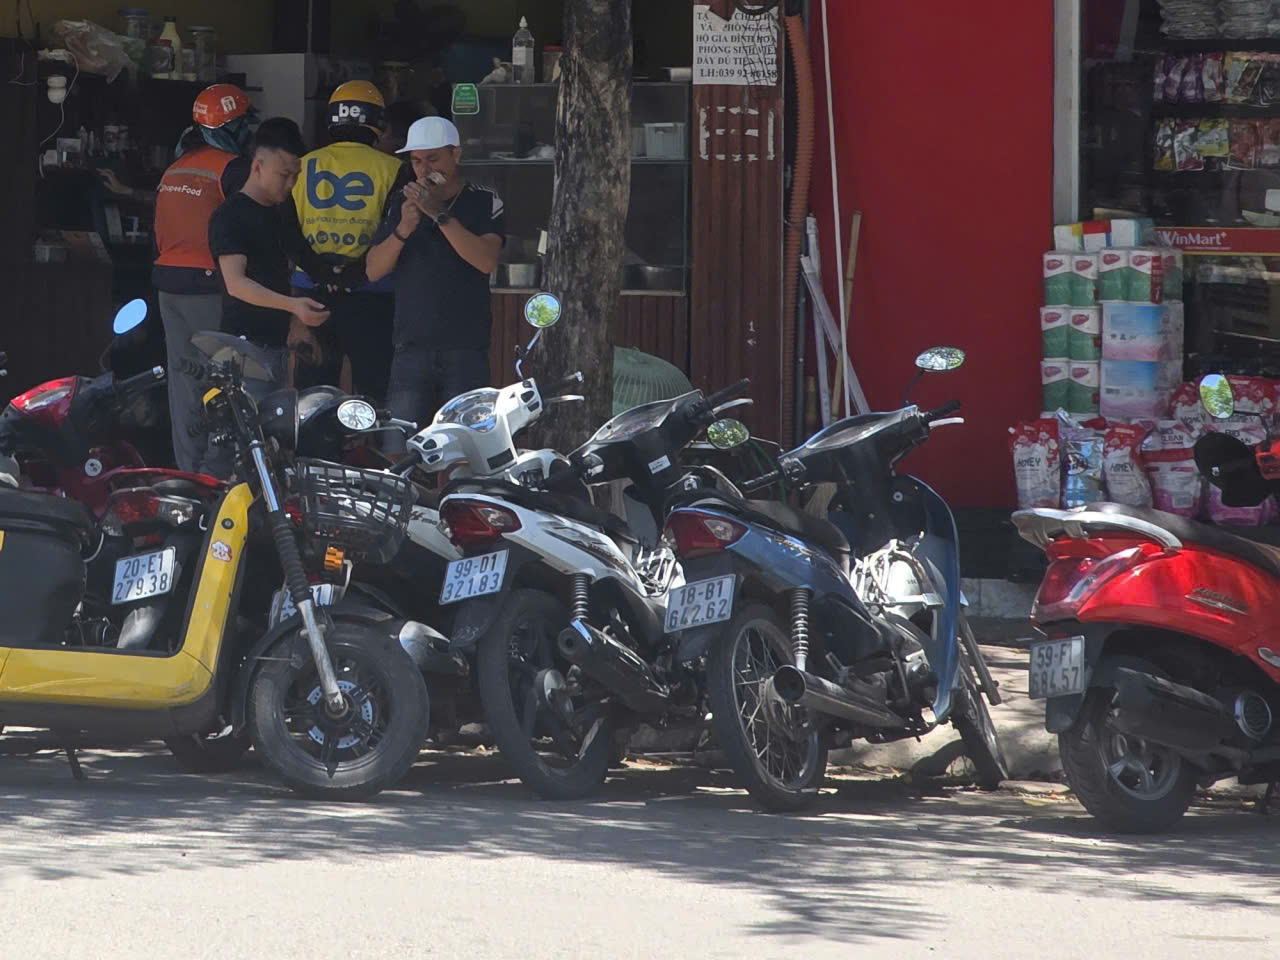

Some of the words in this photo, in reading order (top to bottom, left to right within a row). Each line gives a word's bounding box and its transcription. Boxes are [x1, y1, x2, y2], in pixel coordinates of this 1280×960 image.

[698, 45, 731, 54] PHÒNG
[711, 34, 729, 43] GIA
[338, 103, 361, 118] be
[306, 157, 375, 210] be
[122, 552, 165, 580] 20-E1
[454, 552, 498, 580] 99-D1
[114, 572, 169, 601] 279.38
[444, 572, 500, 602] 321.83
[679, 580, 725, 608] 18-B1
[669, 598, 728, 630] 642.62
